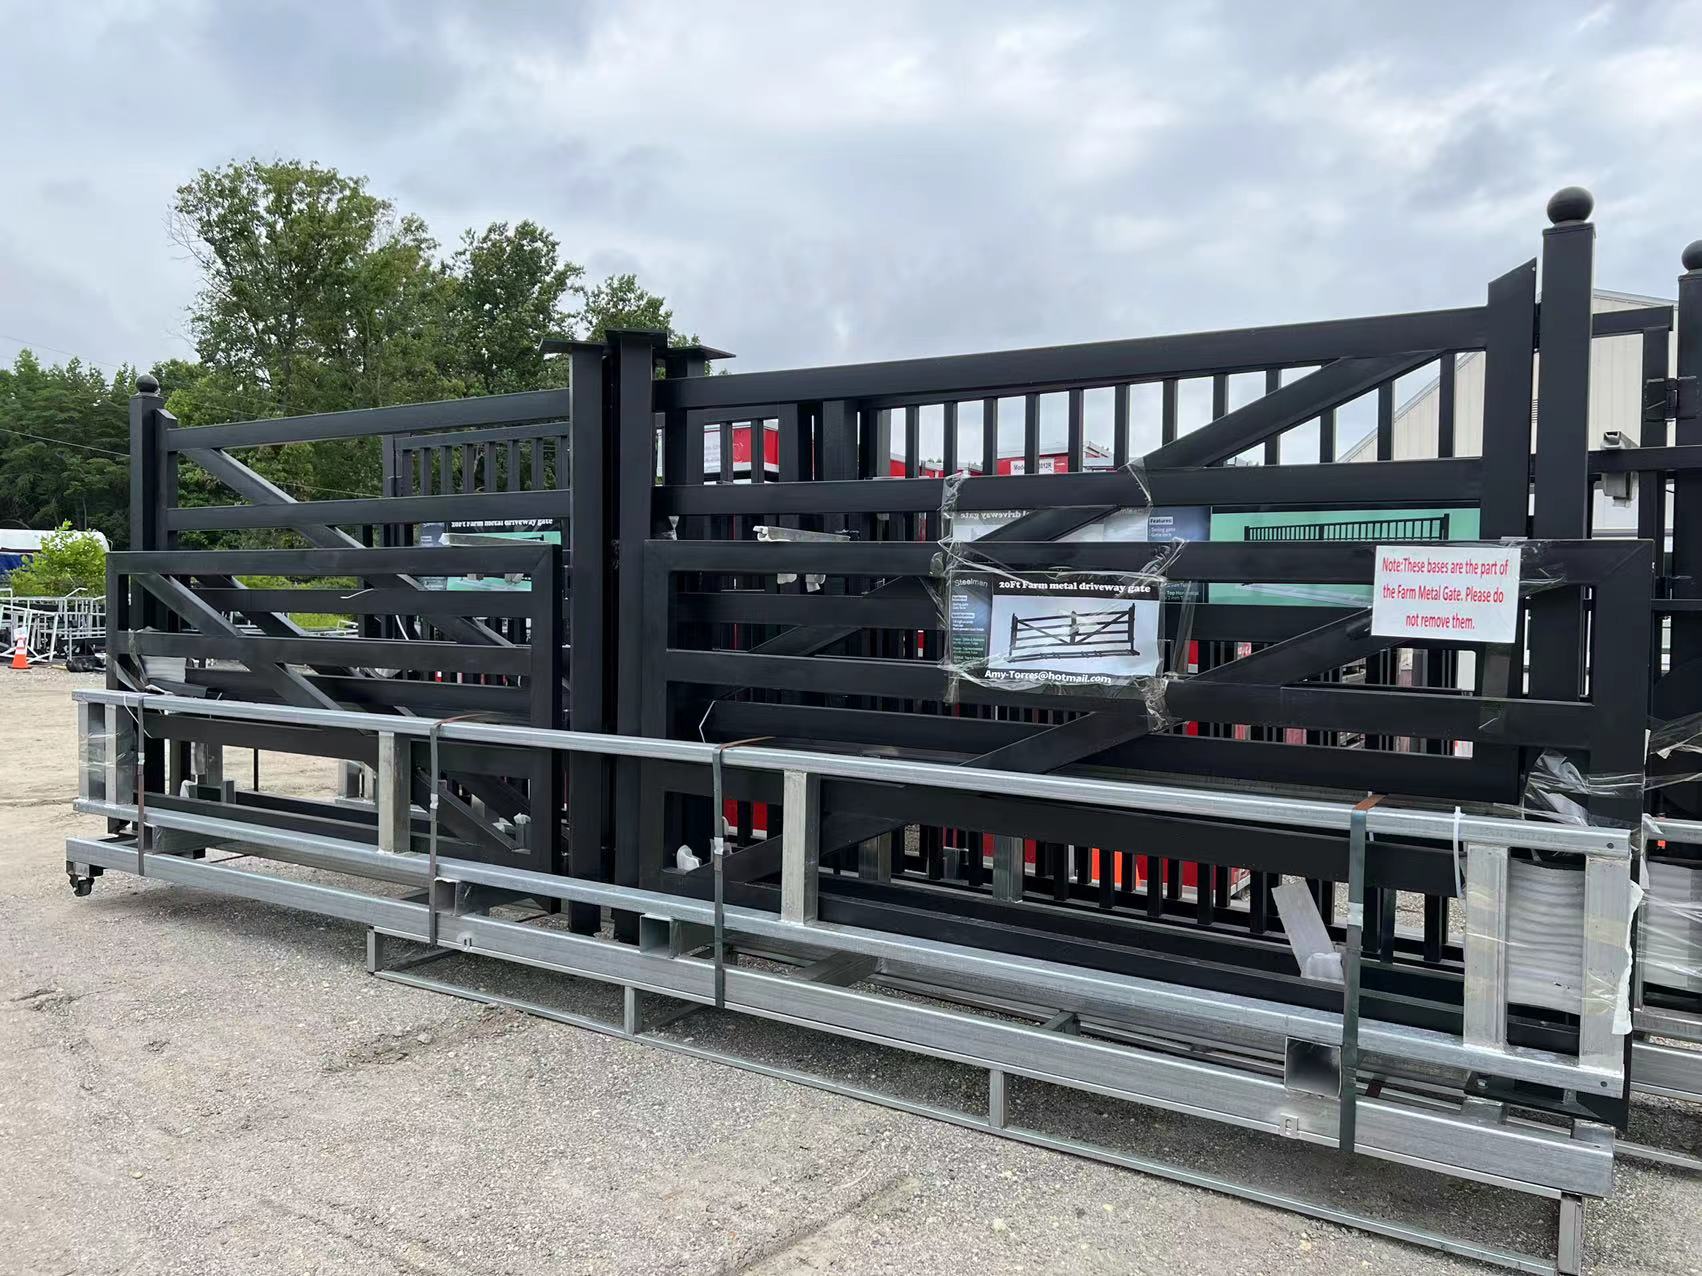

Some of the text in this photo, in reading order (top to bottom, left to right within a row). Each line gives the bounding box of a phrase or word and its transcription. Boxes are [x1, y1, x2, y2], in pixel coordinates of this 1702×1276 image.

[1382, 557, 1509, 578] Note:These bases are the part of
[999, 581, 1151, 594] 20Ft Farm metal driveway gate
[1383, 584, 1504, 603] the Farm Metal Gate. Please do
[1405, 613, 1475, 629] not remove them.
[984, 669, 1112, 684] Amy-Torres@hotmail.com
